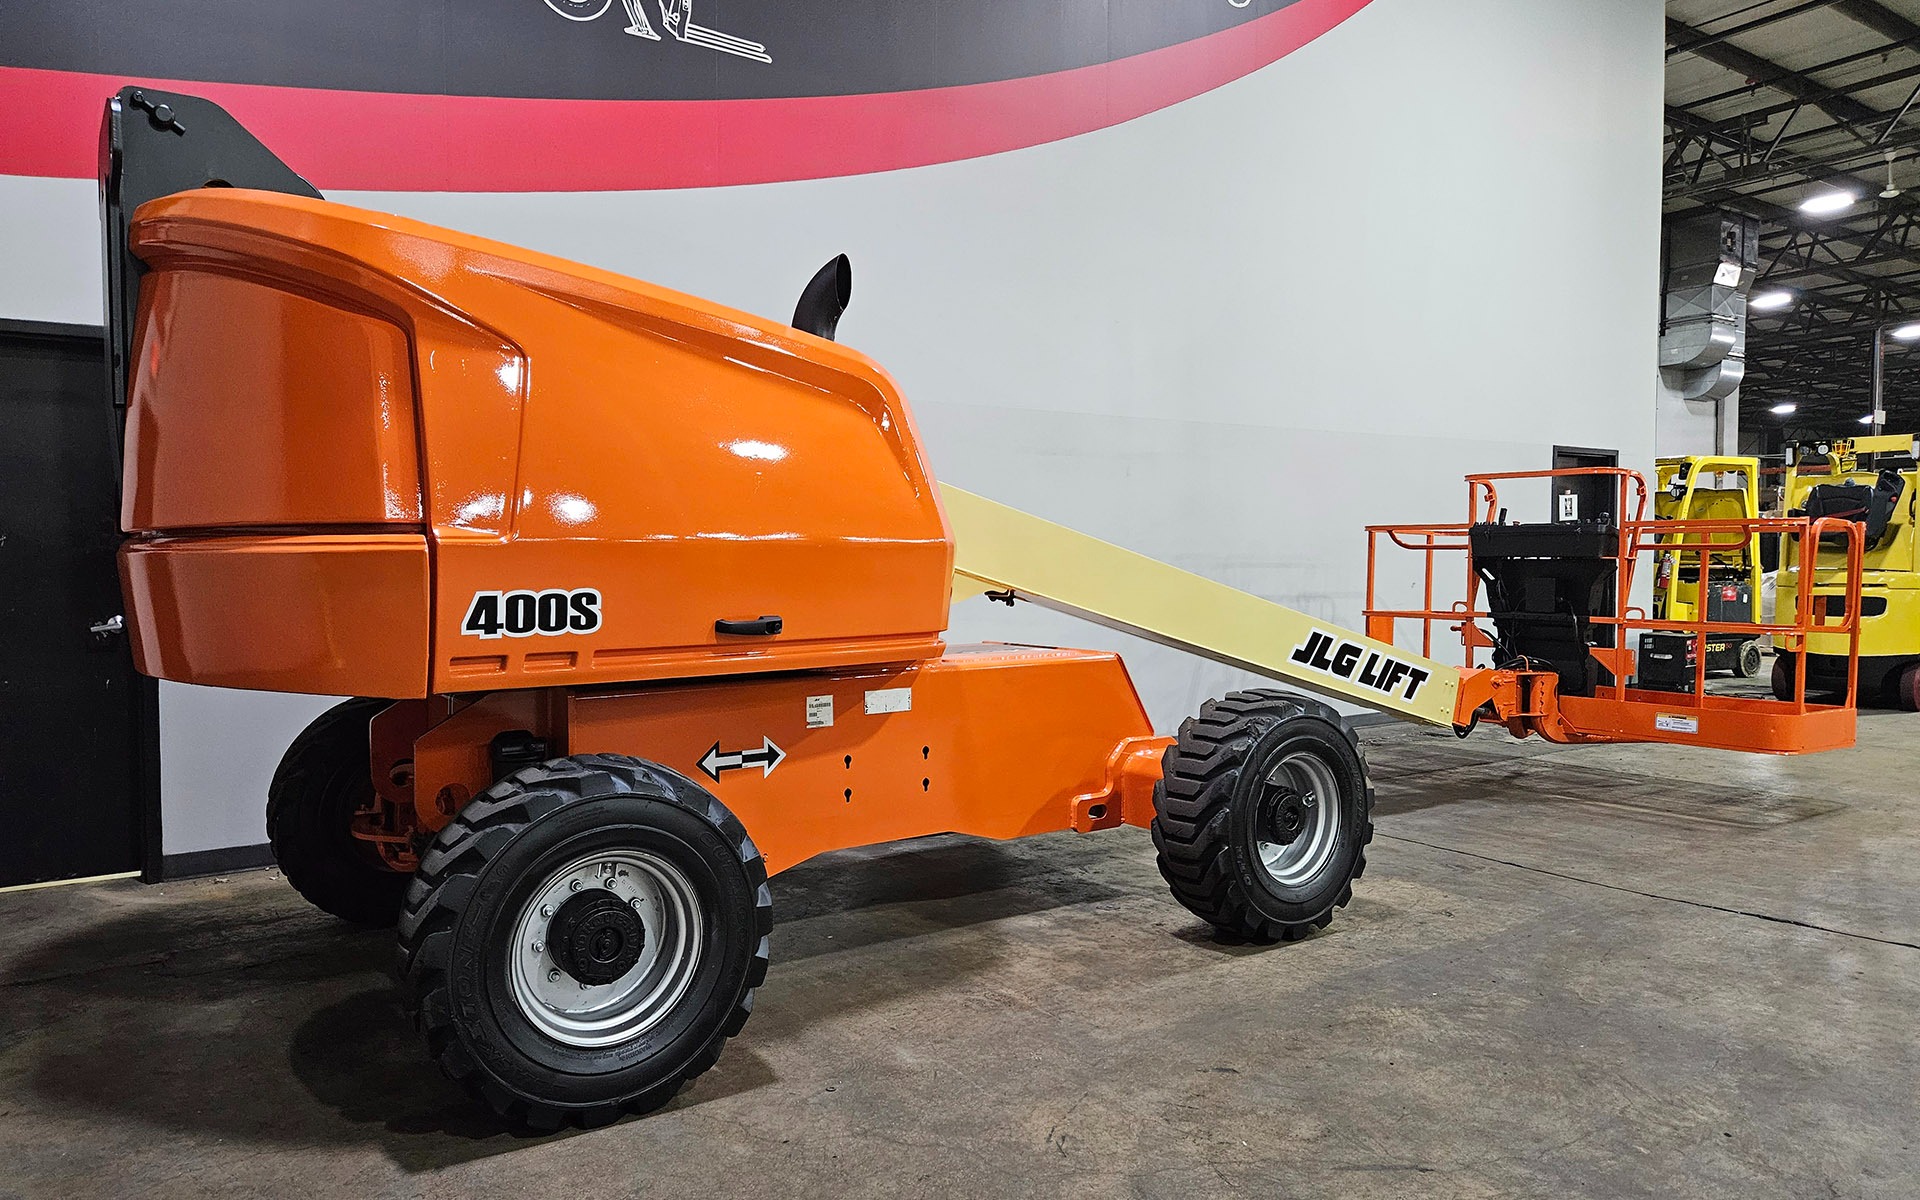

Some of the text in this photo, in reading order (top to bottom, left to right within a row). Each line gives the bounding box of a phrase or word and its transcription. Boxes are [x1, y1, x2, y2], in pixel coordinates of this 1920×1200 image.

[464, 590, 600, 637] 400S
[1290, 630, 1430, 700] JLG LIFT
[1704, 643, 1725, 653] STER
